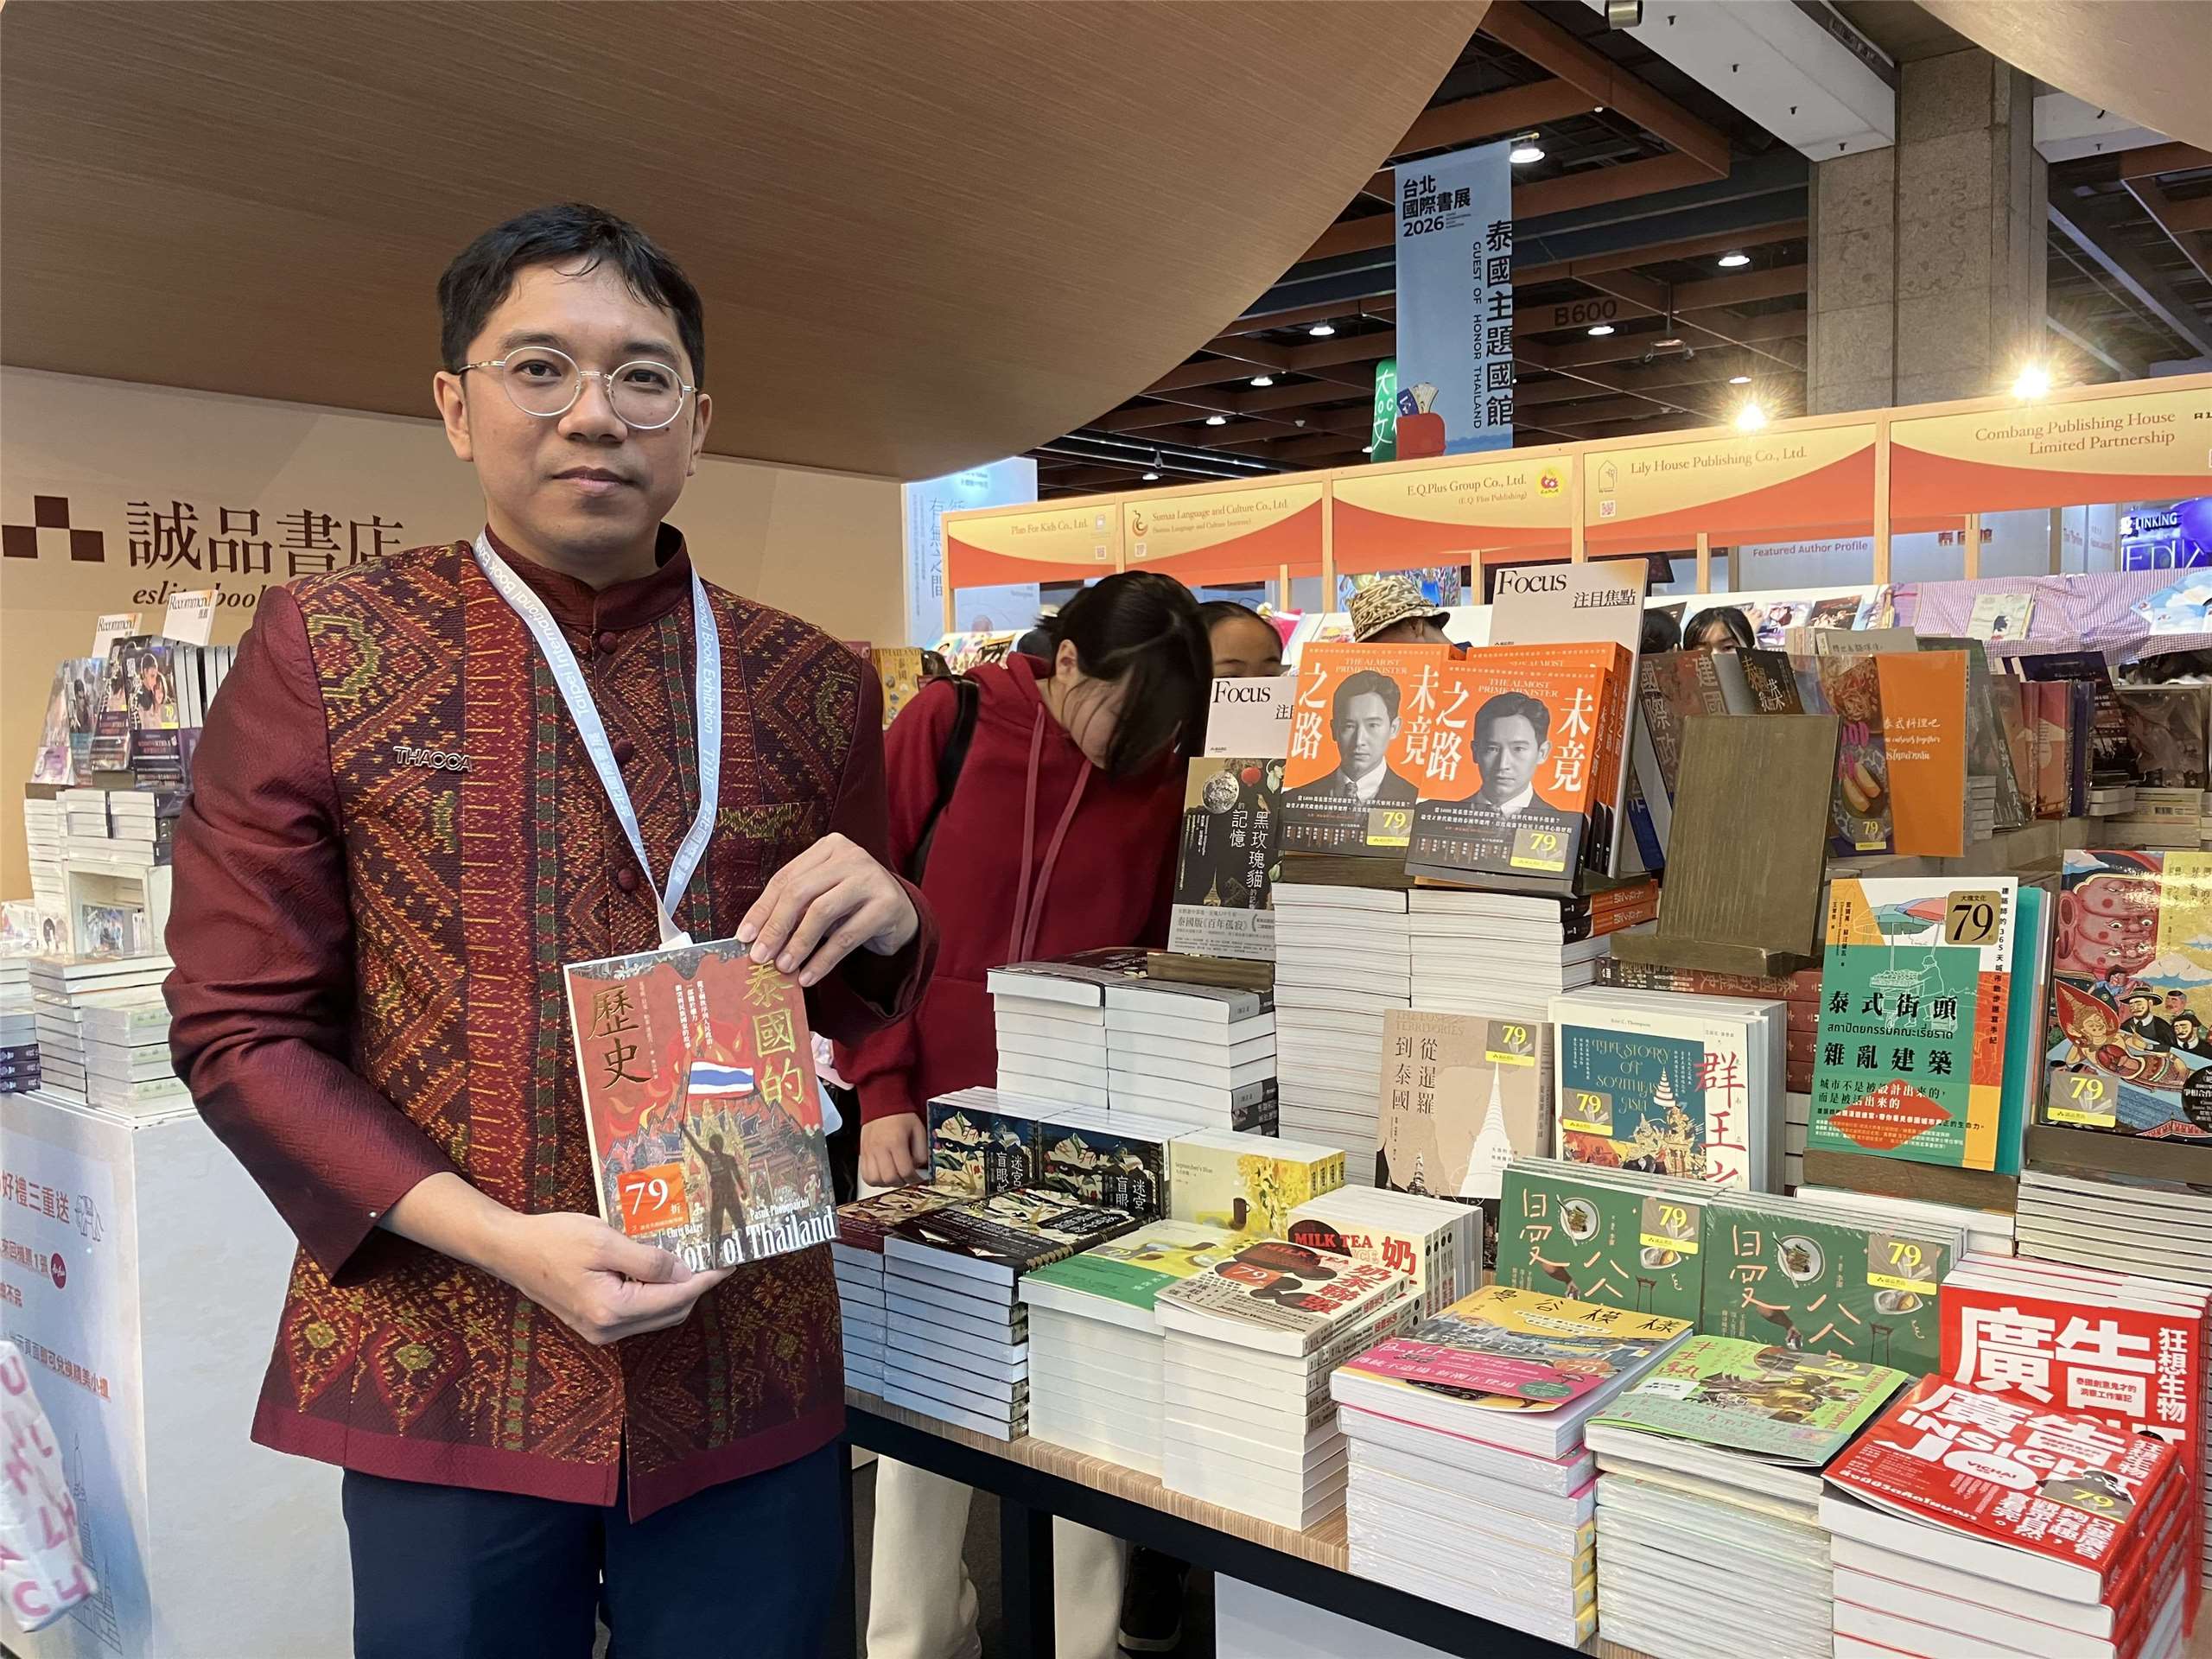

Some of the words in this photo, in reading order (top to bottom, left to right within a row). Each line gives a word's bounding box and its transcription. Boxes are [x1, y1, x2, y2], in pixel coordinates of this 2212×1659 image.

[1403, 175, 1436, 198] 台北
[1402, 188, 1471, 219] 國際書展
[1403, 216, 1444, 237] 2026
[1472, 242, 1482, 281] GUEST
[1473, 288, 1482, 304] OF
[1486, 220, 1512, 426] 泰國主題國館
[1555, 300, 1618, 326] B600
[1473, 315, 1482, 359] HONOR
[1473, 366, 1482, 429] THAILAND
[1975, 426, 2044, 442] Combang
[2048, 417, 2124, 435] Publishing
[2127, 411, 2176, 425] House
[2029, 437, 2085, 455] Limited
[2090, 431, 2176, 450] Partnership
[1630, 461, 1651, 477] Lily
[1654, 458, 1690, 472] House
[1693, 453, 1752, 469] Publishing
[1755, 450, 1779, 464] Co.,
[1783, 446, 1808, 459] Ltd.
[1449, 478, 1481, 493] Group
[1483, 476, 1503, 489] Co.,
[1506, 474, 1527, 486] Ltd.
[1177, 507, 1211, 521] Language
[1211, 505, 1225, 516] and
[1226, 504, 1255, 516] Culture
[1273, 499, 1288, 510] Ltd.
[2135, 512, 2178, 531] LINKING
[126, 501, 404, 577] 誠品書店
[1040, 522, 1057, 533] Kids
[1752, 543, 1796, 558] Featured
[1797, 543, 1830, 556] Author
[1834, 540, 1868, 553] Profile
[489, 560, 516, 595] Book
[1496, 569, 1567, 596] Focus
[1573, 590, 1637, 609] 注目焦點
[512, 586, 569, 668] International
[702, 632, 714, 666] Book
[564, 671, 589, 717] Taipei
[1212, 680, 1272, 703] Focus
[1488, 677, 1510, 686] THE
[1510, 678, 1552, 690] ALMOST
[702, 668, 716, 734] Exhibition
[1291, 662, 1328, 760] 之路
[1402, 664, 1440, 768] 未竟
[1426, 682, 1470, 782] 之路
[1553, 687, 1595, 792] 未竟
[393, 745, 473, 772] THACCA
[1382, 811, 1407, 830] 79
[1863, 821, 1878, 834] 79
[1246, 810, 1269, 888] 黑玫瑰貓
[1529, 833, 1557, 851] 79
[1953, 904, 1993, 942] 79
[1828, 990, 1959, 1020] 泰式街頭
[588, 983, 654, 1090] 歷史
[743, 960, 806, 1107] 泰國的
[1502, 1025, 1528, 1045] 79
[1392, 1036, 1413, 1112] 到泰國
[1824, 1042, 1953, 1075] 雜亂建築
[1416, 1037, 1438, 1115] 從暹羅
[2069, 1077, 2104, 1101] 79
[1576, 1093, 1602, 1114] 79
[1010, 1154, 1024, 1188] 迷宮
[626, 1179, 669, 1216] 79
[1132, 1179, 1147, 1211] 迷宮
[684, 1222, 704, 1236] Baker
[1657, 1205, 1688, 1230] 79
[723, 1230, 745, 1265] of
[745, 1205, 837, 1260] Thailand
[1294, 1232, 1338, 1248] MILK
[1339, 1234, 1374, 1249] TEA
[1381, 1236, 1418, 1275] 奶
[1886, 1242, 1922, 1268] 79
[1230, 1266, 1268, 1281] 79
[1299, 1263, 1393, 1315] 奶茶聯盟
[1565, 1365, 1598, 1375] 79
[1823, 1359, 1860, 1371] 79
[1954, 1305, 2156, 1419] 廣告
[2157, 1327, 2189, 1424] 狂想生物
[2075, 1376, 2138, 1394] 泰國創意鬼才的
[1915, 1384, 2127, 1468] 廣告
[1966, 1458, 2018, 1480] VICHAI
[2073, 1489, 2115, 1508] 79
